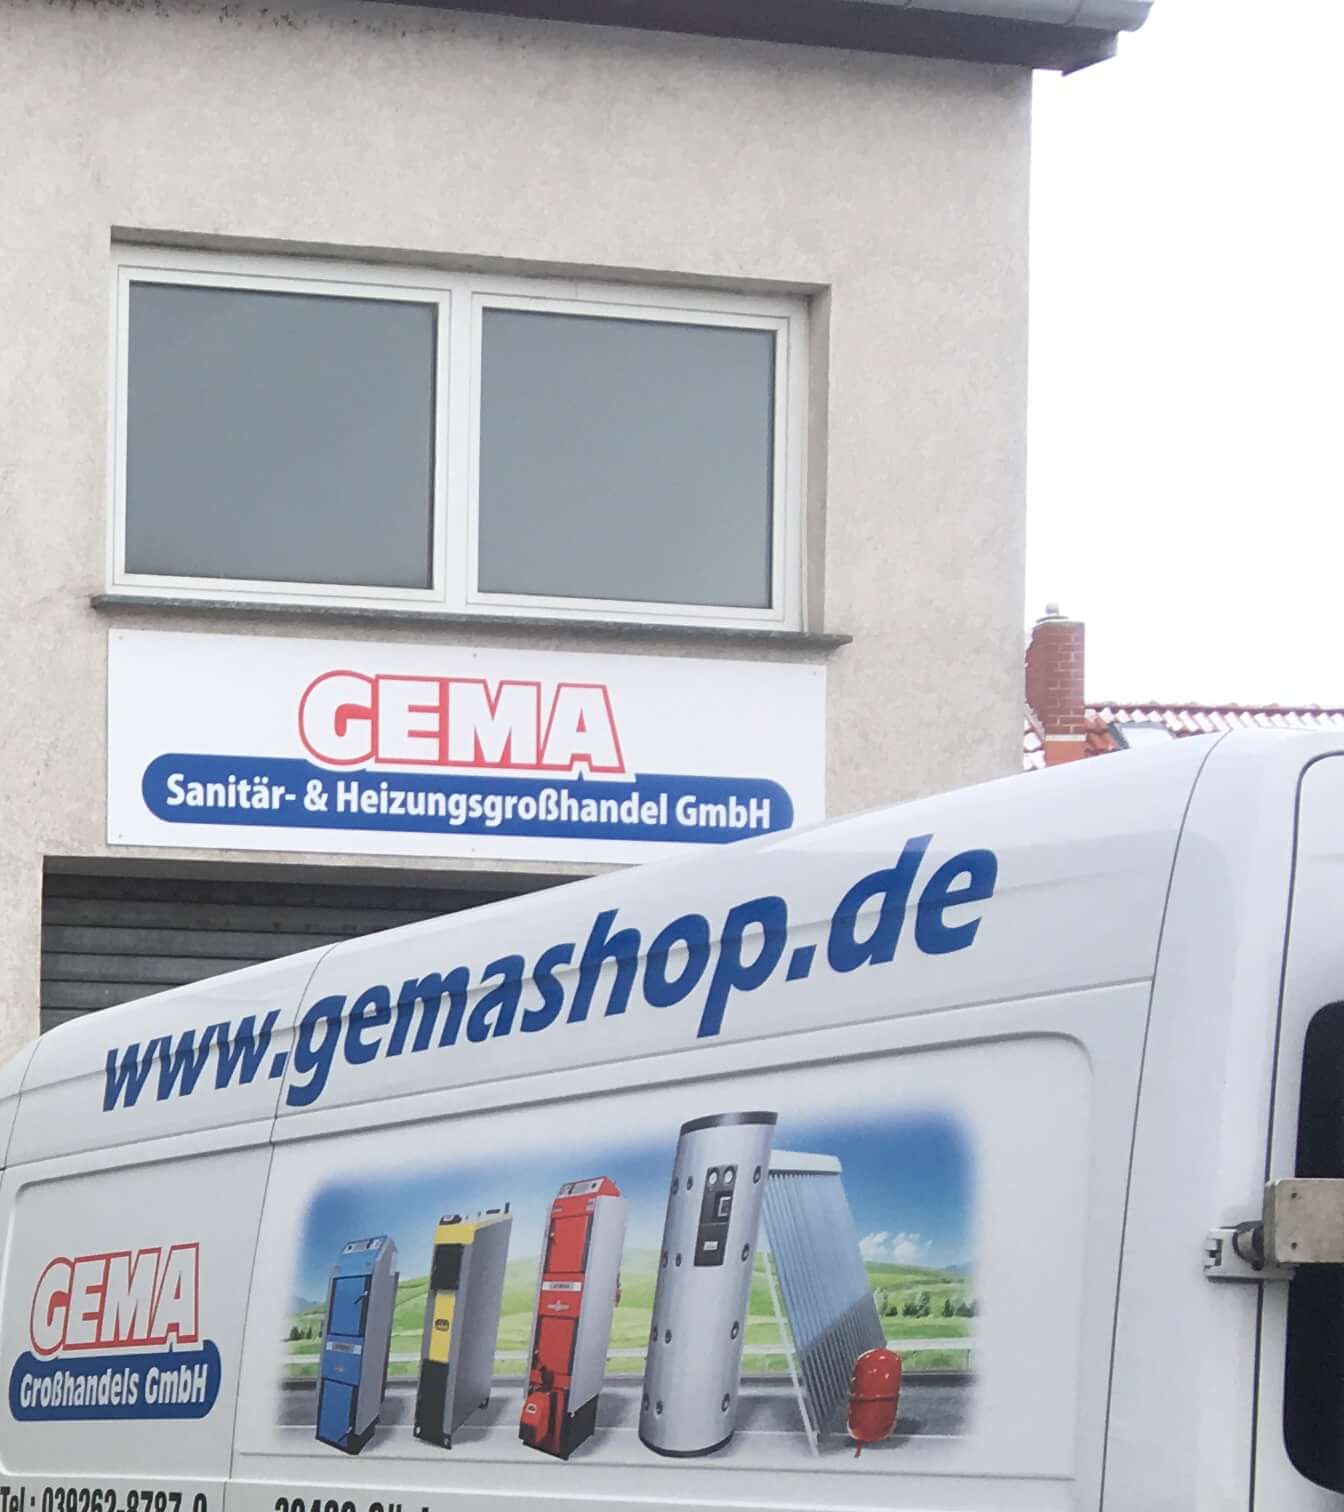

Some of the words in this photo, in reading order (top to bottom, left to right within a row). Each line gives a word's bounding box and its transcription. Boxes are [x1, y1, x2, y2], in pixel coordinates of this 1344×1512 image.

[298, 669, 626, 774] GEMA
[165, 772, 297, 811] Sanitär-
[302, 778, 329, 813] &
[336, 780, 668, 828] Heizungsgroßhandel
[675, 794, 771, 830] GmbH
[102, 834, 998, 1111] www.gemashop.de
[29, 1242, 200, 1357] GEMA
[19, 1367, 140, 1409] Großhandels
[144, 1363, 209, 1405] GmbH
